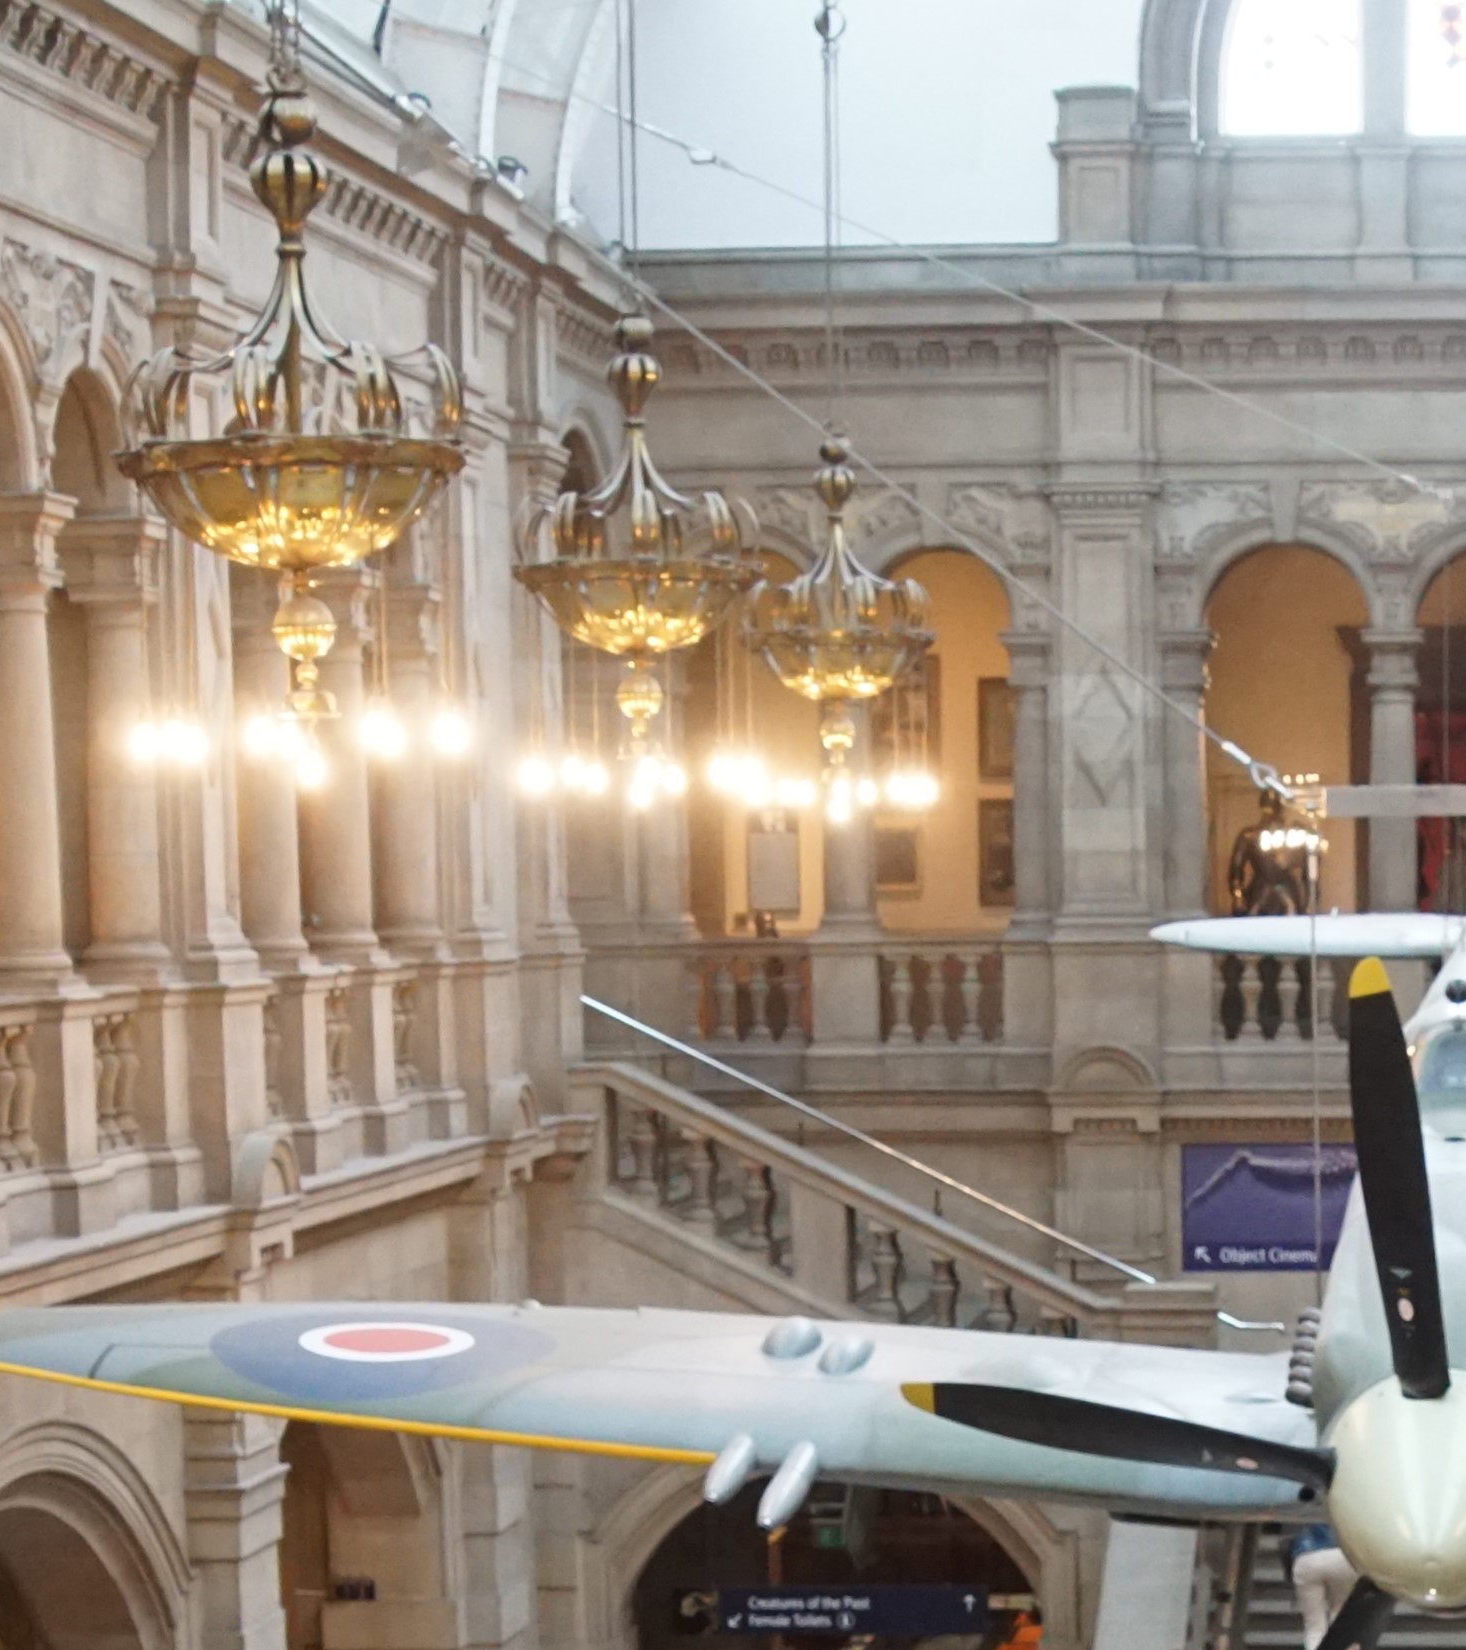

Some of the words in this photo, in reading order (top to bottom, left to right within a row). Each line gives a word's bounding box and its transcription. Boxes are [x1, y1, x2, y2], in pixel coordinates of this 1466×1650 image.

[1218, 1246, 1266, 1265] Object
[747, 1595, 804, 1611] Creatures
[805, 1595, 820, 1611] of
[821, 1596, 841, 1611] the
[843, 1595, 870, 1611] Past
[748, 1613, 791, 1628] Female
[793, 1613, 832, 1628] Toilets
